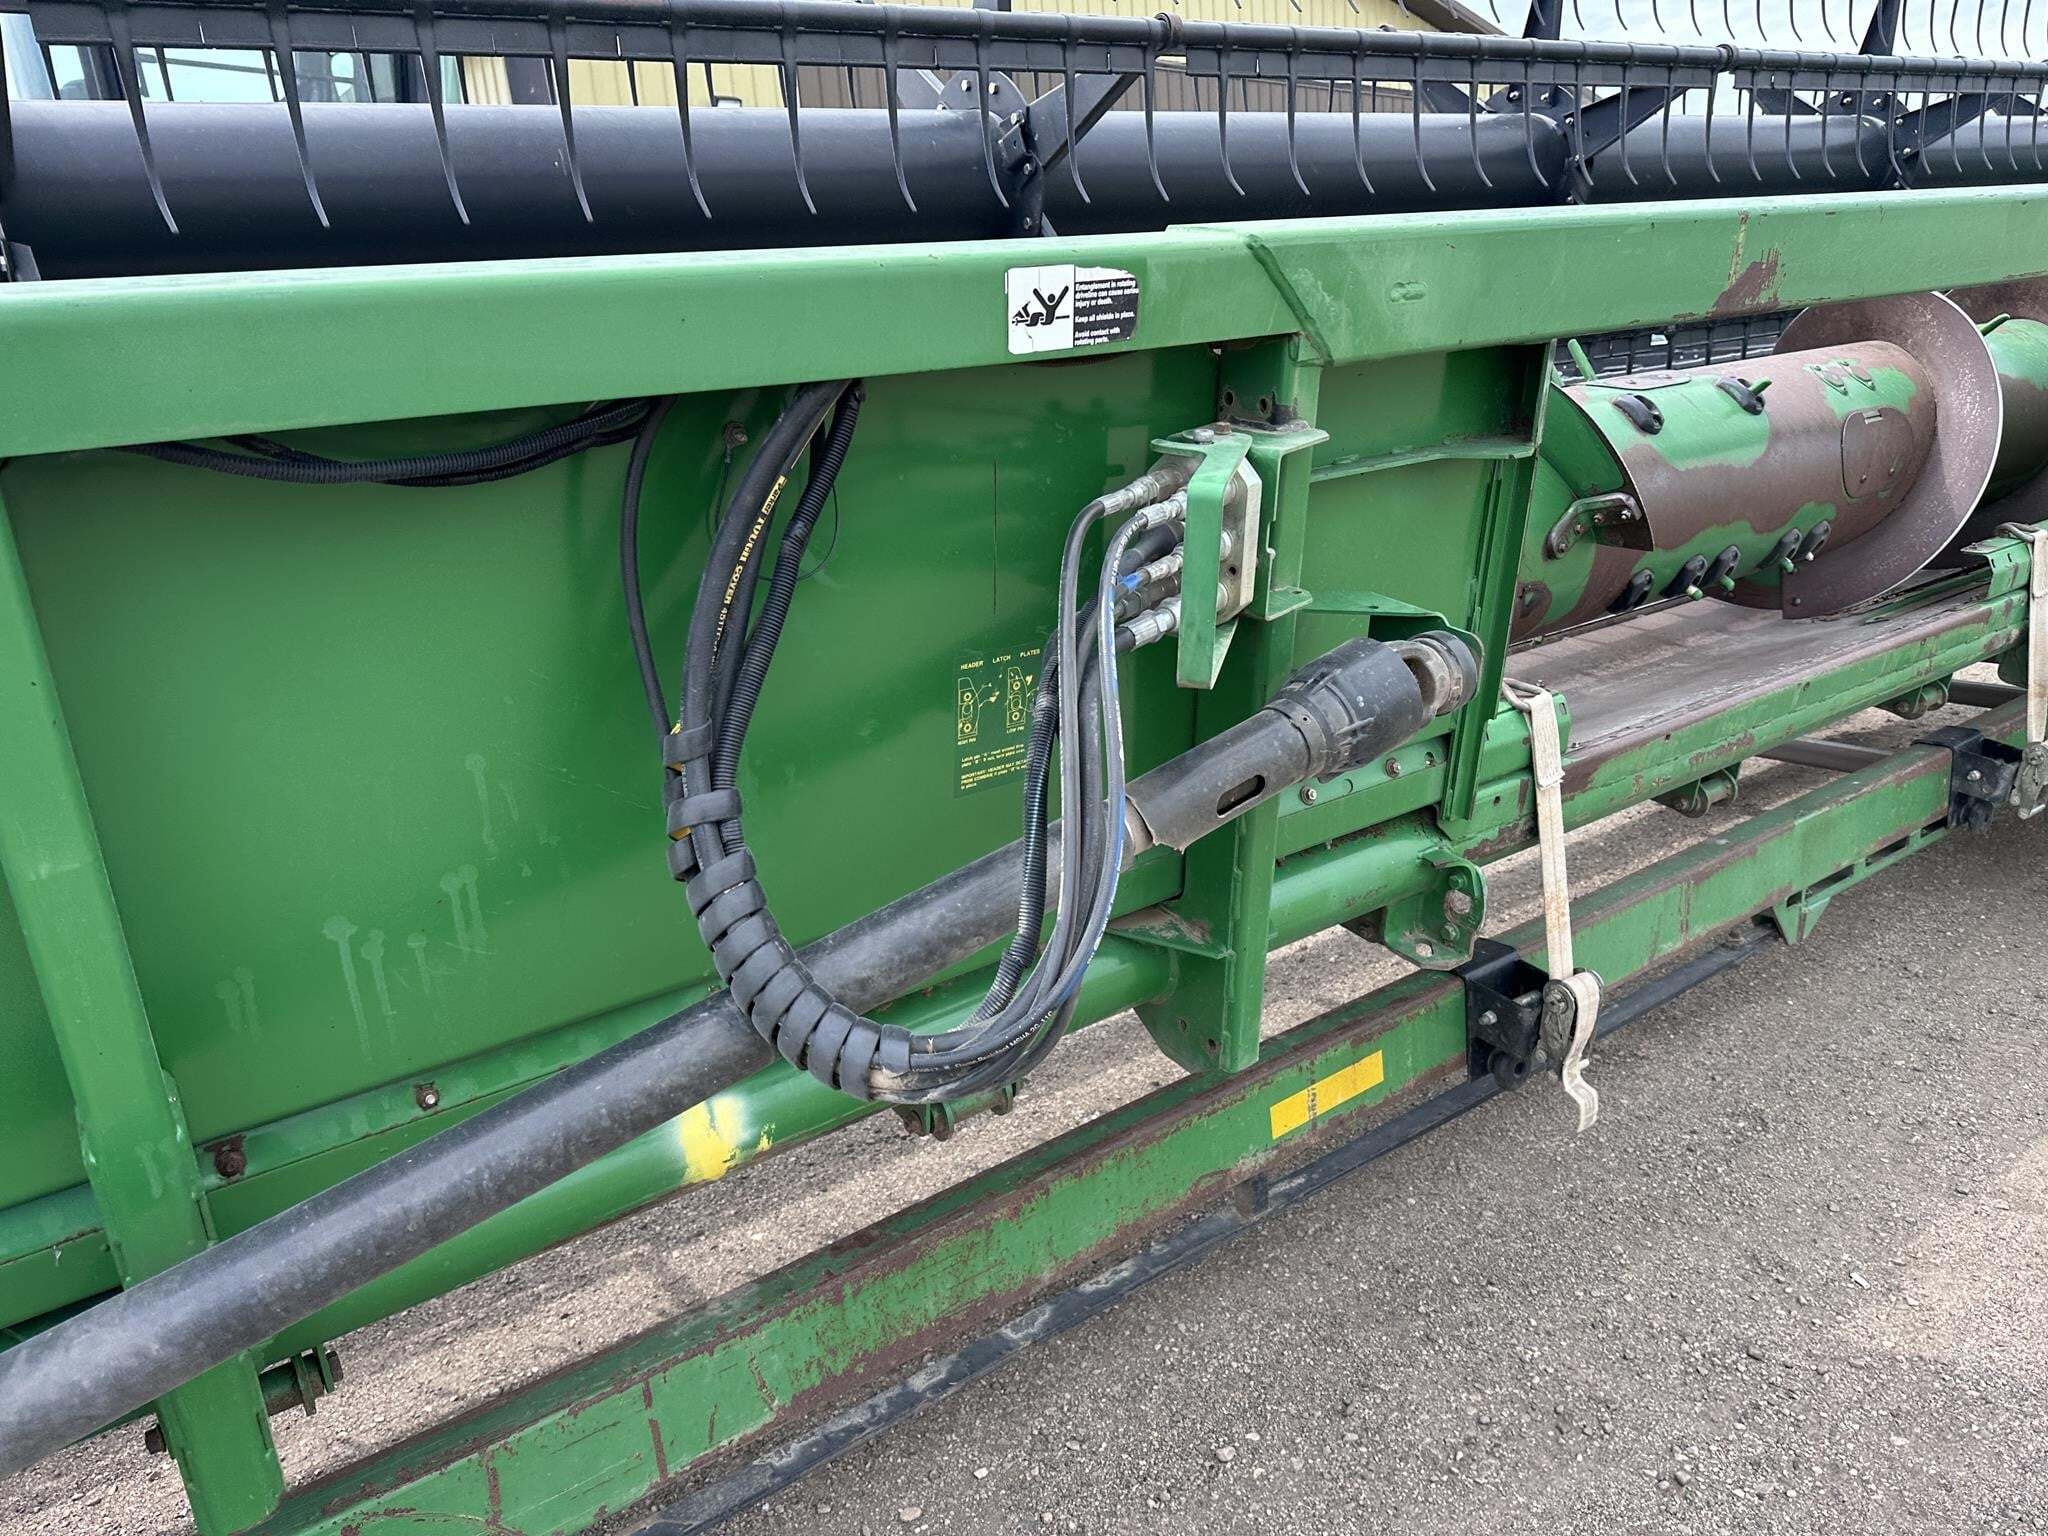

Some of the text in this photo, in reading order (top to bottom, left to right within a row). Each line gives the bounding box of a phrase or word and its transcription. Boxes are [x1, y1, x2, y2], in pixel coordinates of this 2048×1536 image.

[1075, 282, 1110, 291] Entanglement
[1117, 280, 1136, 288] rotating
[1075, 291, 1097, 299] driveline
[1075, 300, 1090, 308] injury
[1097, 297, 1113, 305] death.
[1120, 311, 1135, 320] place.
[1075, 330, 1089, 338] Avoid
[1090, 328, 1109, 336] contact
[1074, 337, 1109, 346] rotating parts.
[740, 517, 767, 562] TOUGH
[724, 564, 743, 604] COVER
[960, 648, 1041, 670] HEADER LATCH PLATES
